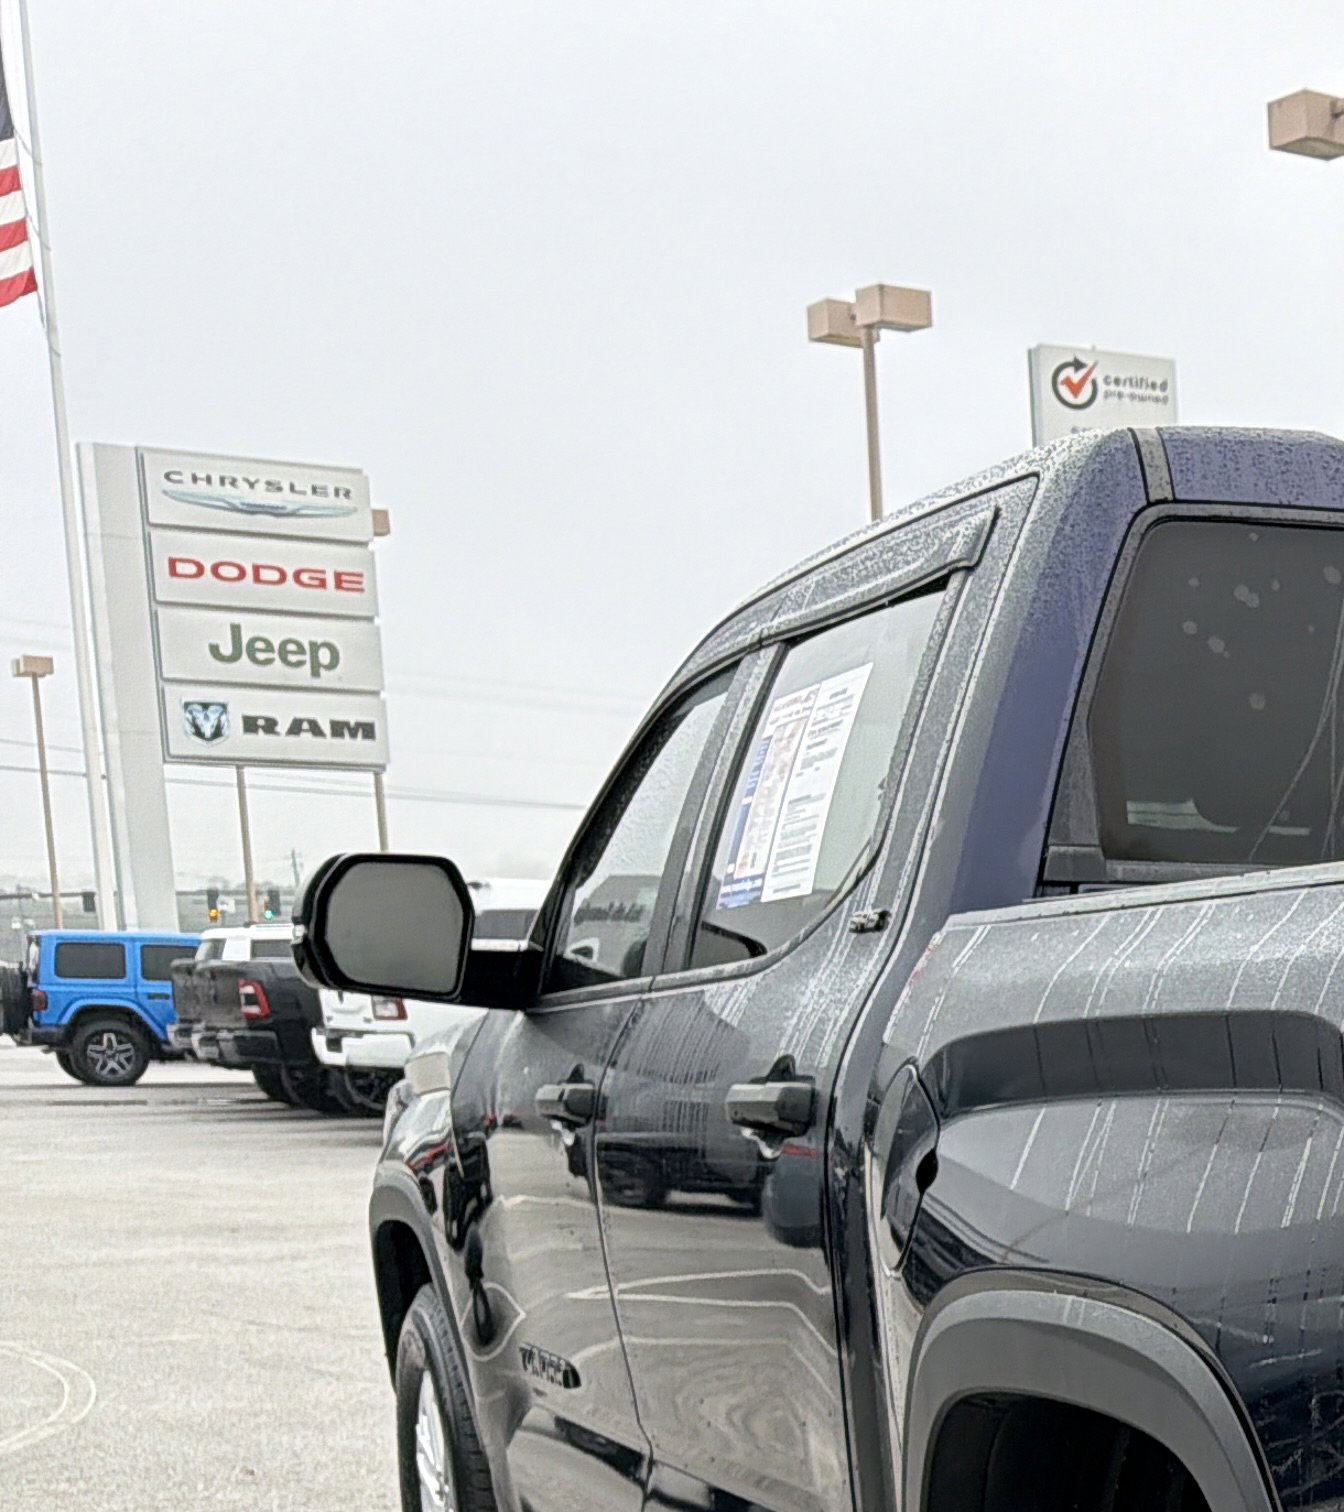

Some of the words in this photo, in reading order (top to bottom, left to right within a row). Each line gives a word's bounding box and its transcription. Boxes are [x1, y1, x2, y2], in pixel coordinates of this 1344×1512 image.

[1103, 374, 1169, 393] certified
[163, 470, 352, 500] CHRYSLER
[168, 557, 365, 593] DODGE
[208, 623, 340, 678] Jeep
[242, 714, 377, 741] RAM
